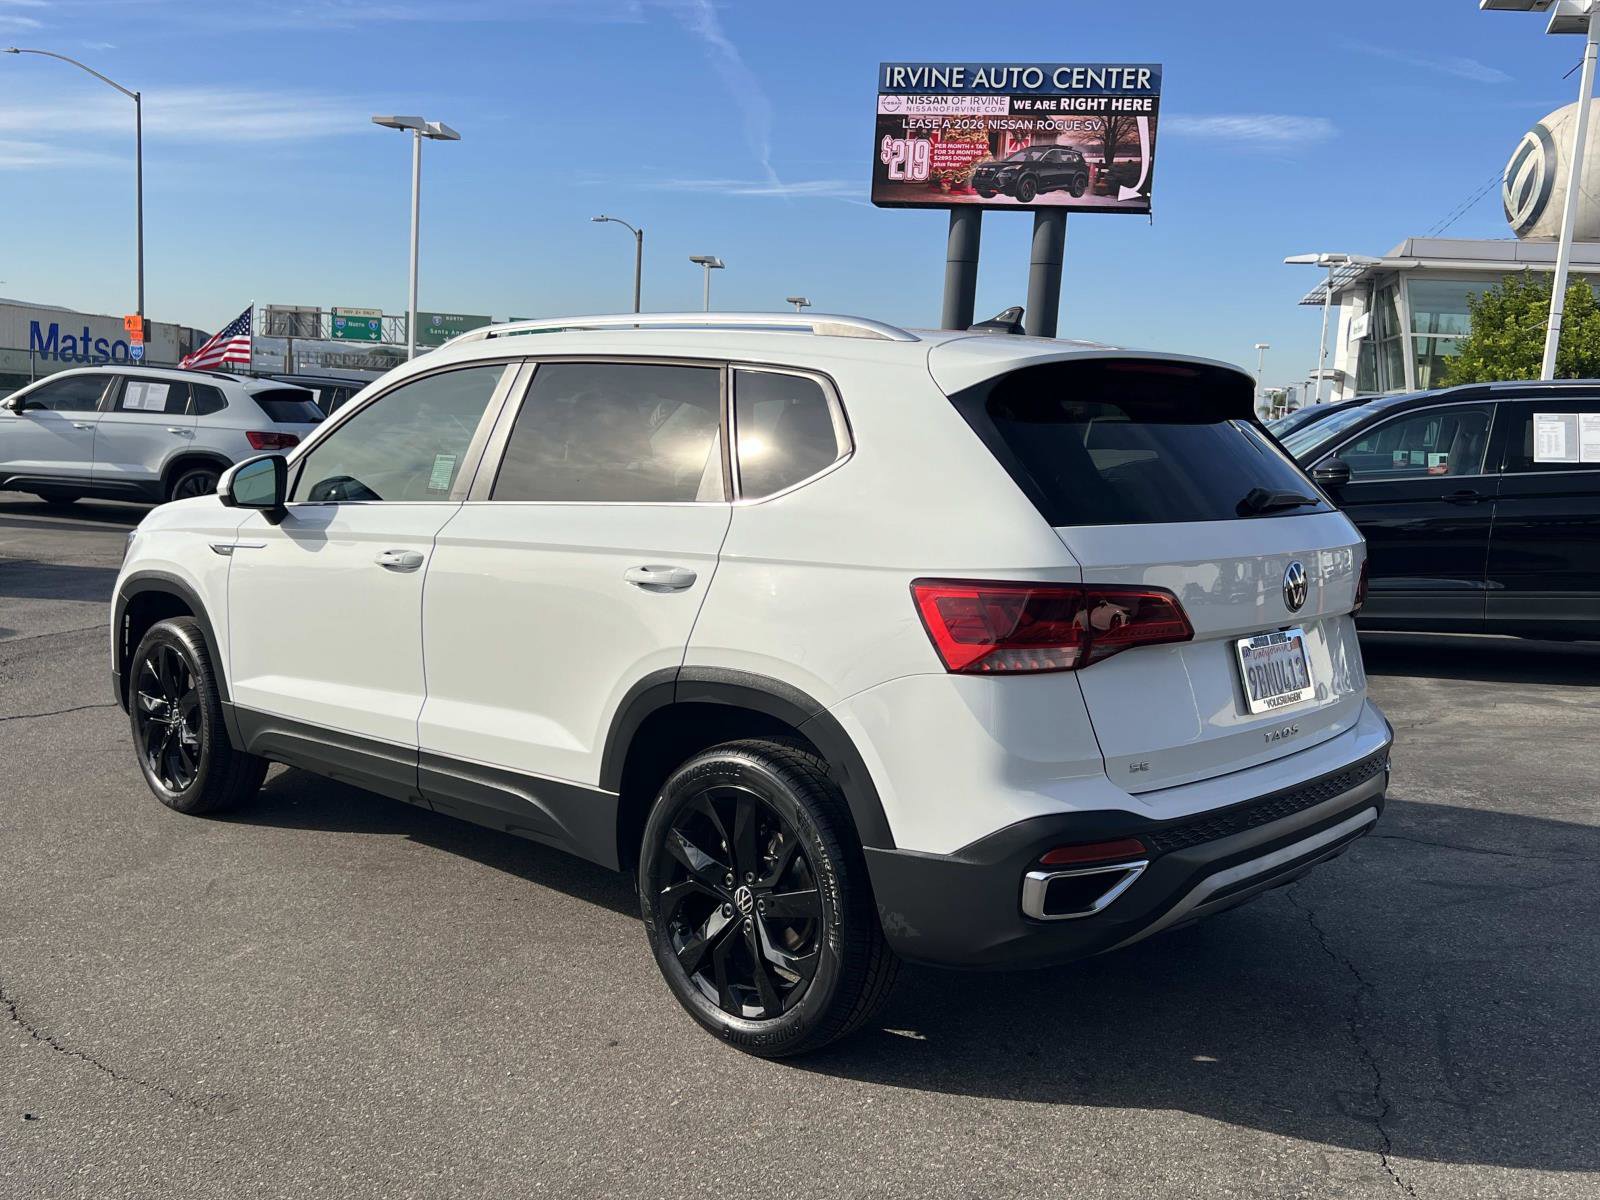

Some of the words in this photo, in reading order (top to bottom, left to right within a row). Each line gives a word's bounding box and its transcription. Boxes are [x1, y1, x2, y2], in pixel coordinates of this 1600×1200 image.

[885, 66, 965, 88] IRVINE
[971, 67, 1044, 89] AUTO
[1052, 67, 1151, 89] CENTER
[906, 96, 948, 105] NISSAN
[951, 96, 967, 105] OF
[970, 96, 1006, 106] IRVINE
[1013, 100, 1032, 110] WE
[1034, 100, 1057, 110] ARE
[1060, 98, 1108, 111] RIGHT
[1111, 99, 1152, 111] HERE
[902, 119, 940, 129] LEASE
[942, 119, 951, 129] A
[954, 119, 985, 130] 2026
[988, 120, 1033, 130] NISSAN
[1036, 120, 1081, 131] ROGUE
[1084, 120, 1102, 131] SV
[881, 135, 931, 181] $219
[1263, 723, 1298, 743] TAOS
[1129, 761, 1150, 773] SE
